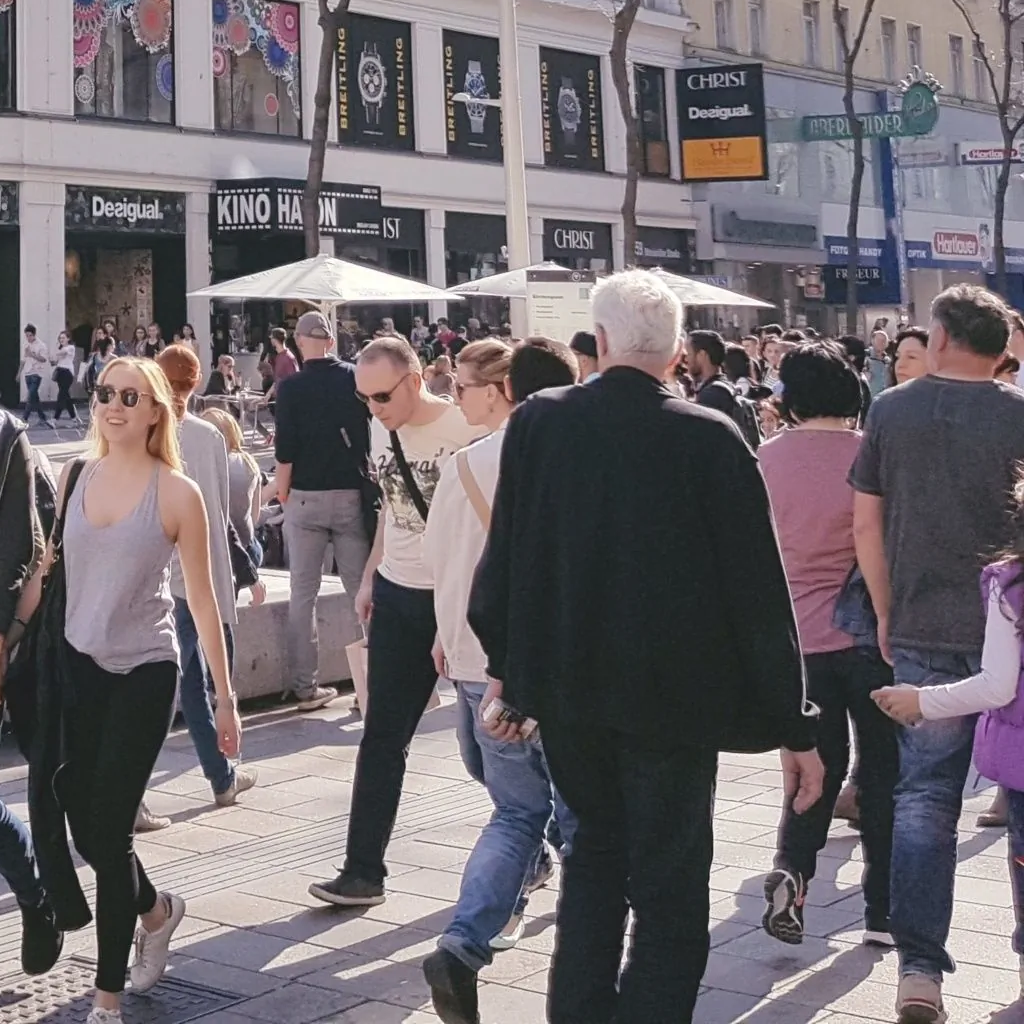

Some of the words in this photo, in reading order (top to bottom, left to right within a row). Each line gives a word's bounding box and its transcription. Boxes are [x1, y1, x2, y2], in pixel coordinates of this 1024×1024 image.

[338, 27, 349, 130] BREITLING
[396, 37, 407, 136] BREITLING
[444, 45, 455, 142] BREITLING
[540, 61, 551, 153] BREITLING
[687, 71, 747, 90] CHRIST
[587, 69, 599, 158] BREITLING
[217, 194, 271, 224] KINO
[554, 228, 595, 250] CHRIST
[907, 249, 927, 260] OPTIK
[937, 233, 977, 256] Hartlauer
